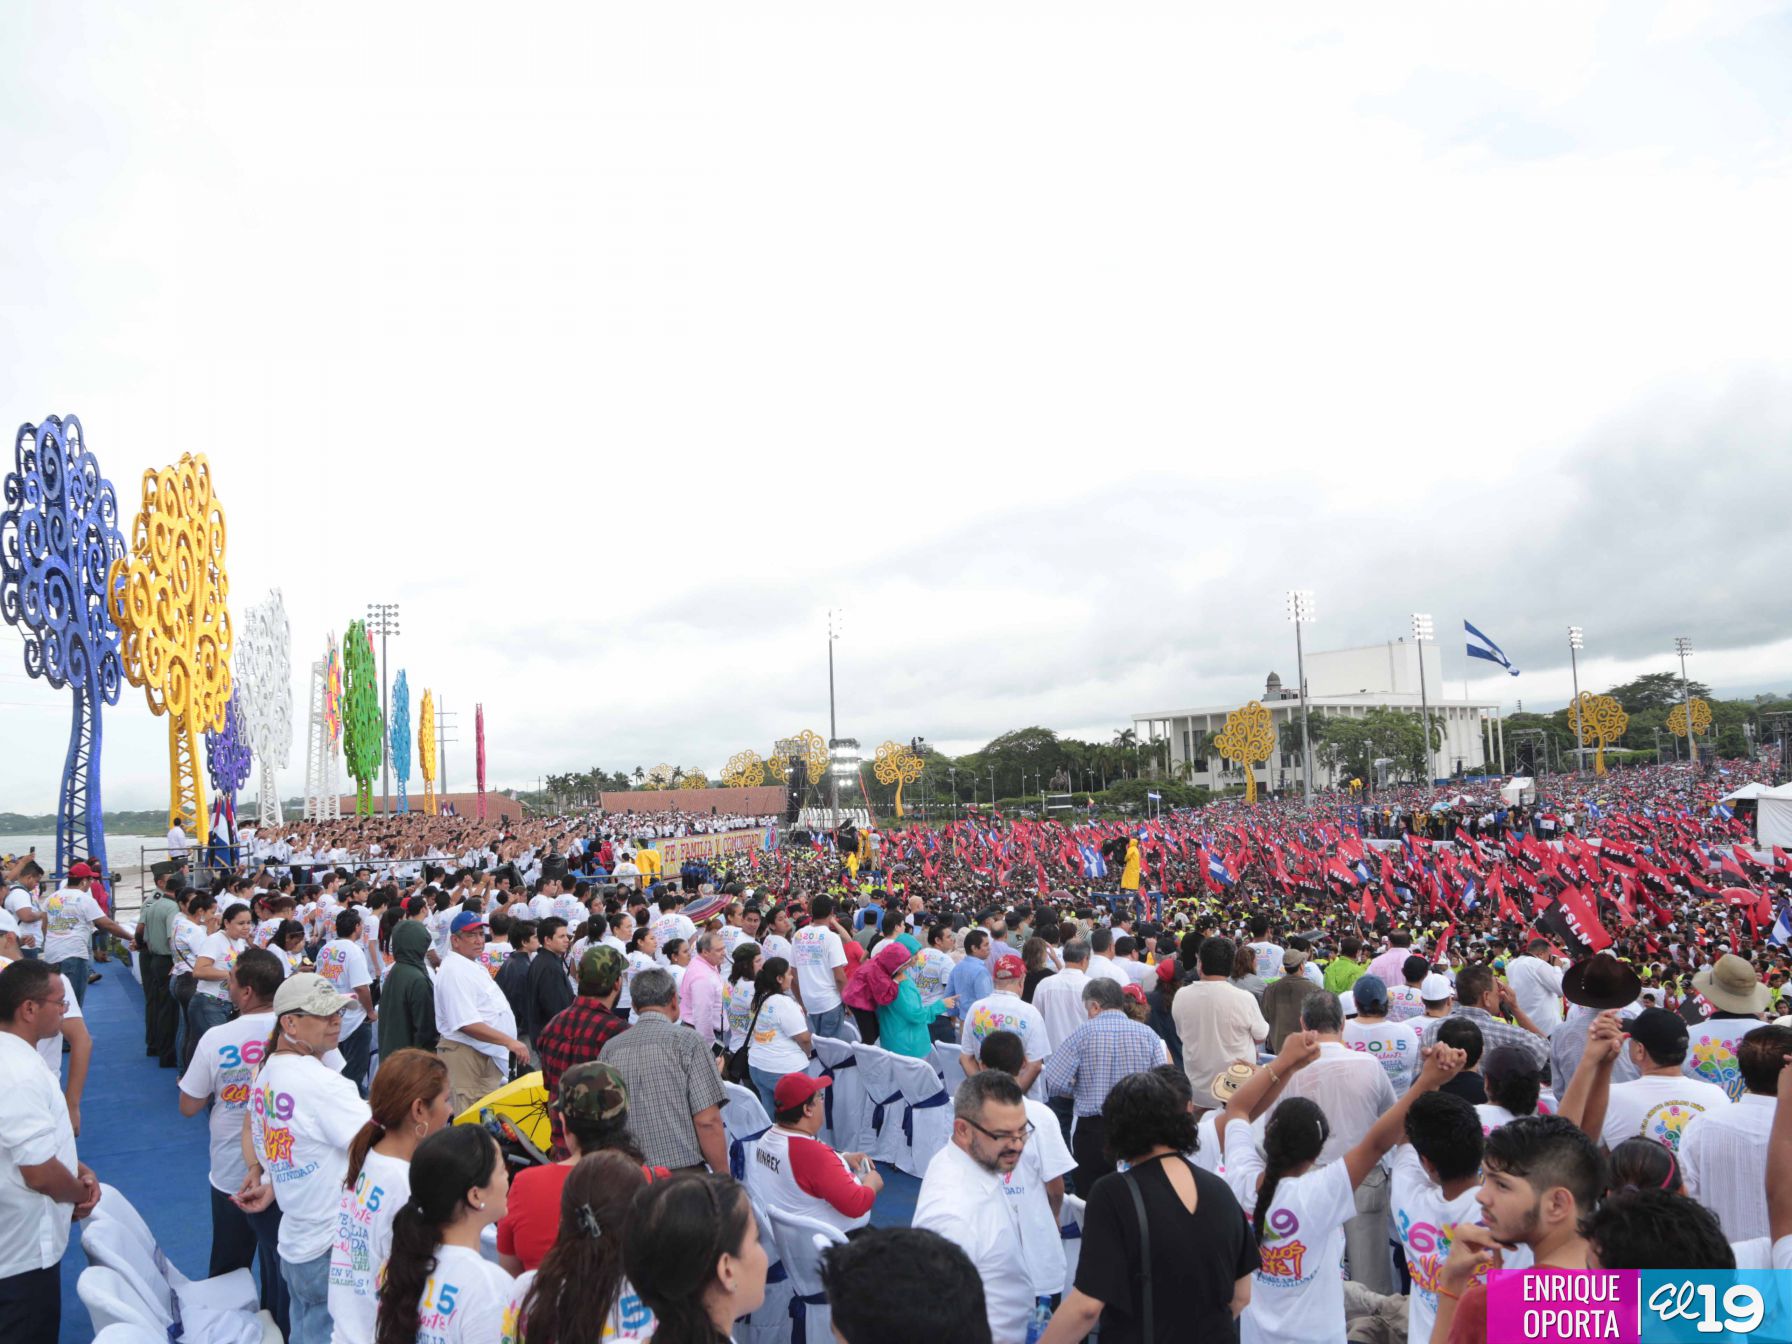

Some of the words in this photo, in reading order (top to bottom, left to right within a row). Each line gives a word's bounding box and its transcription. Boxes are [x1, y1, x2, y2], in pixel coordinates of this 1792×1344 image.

[665, 845, 676, 863] FE
[681, 841, 712, 860] FAMILIA
[716, 838, 720, 855] Y
[1329, 868, 1352, 883] FSLN
[1559, 903, 1592, 946] FSLN
[802, 933, 825, 941] 2015
[1354, 1039, 1407, 1052] 2015
